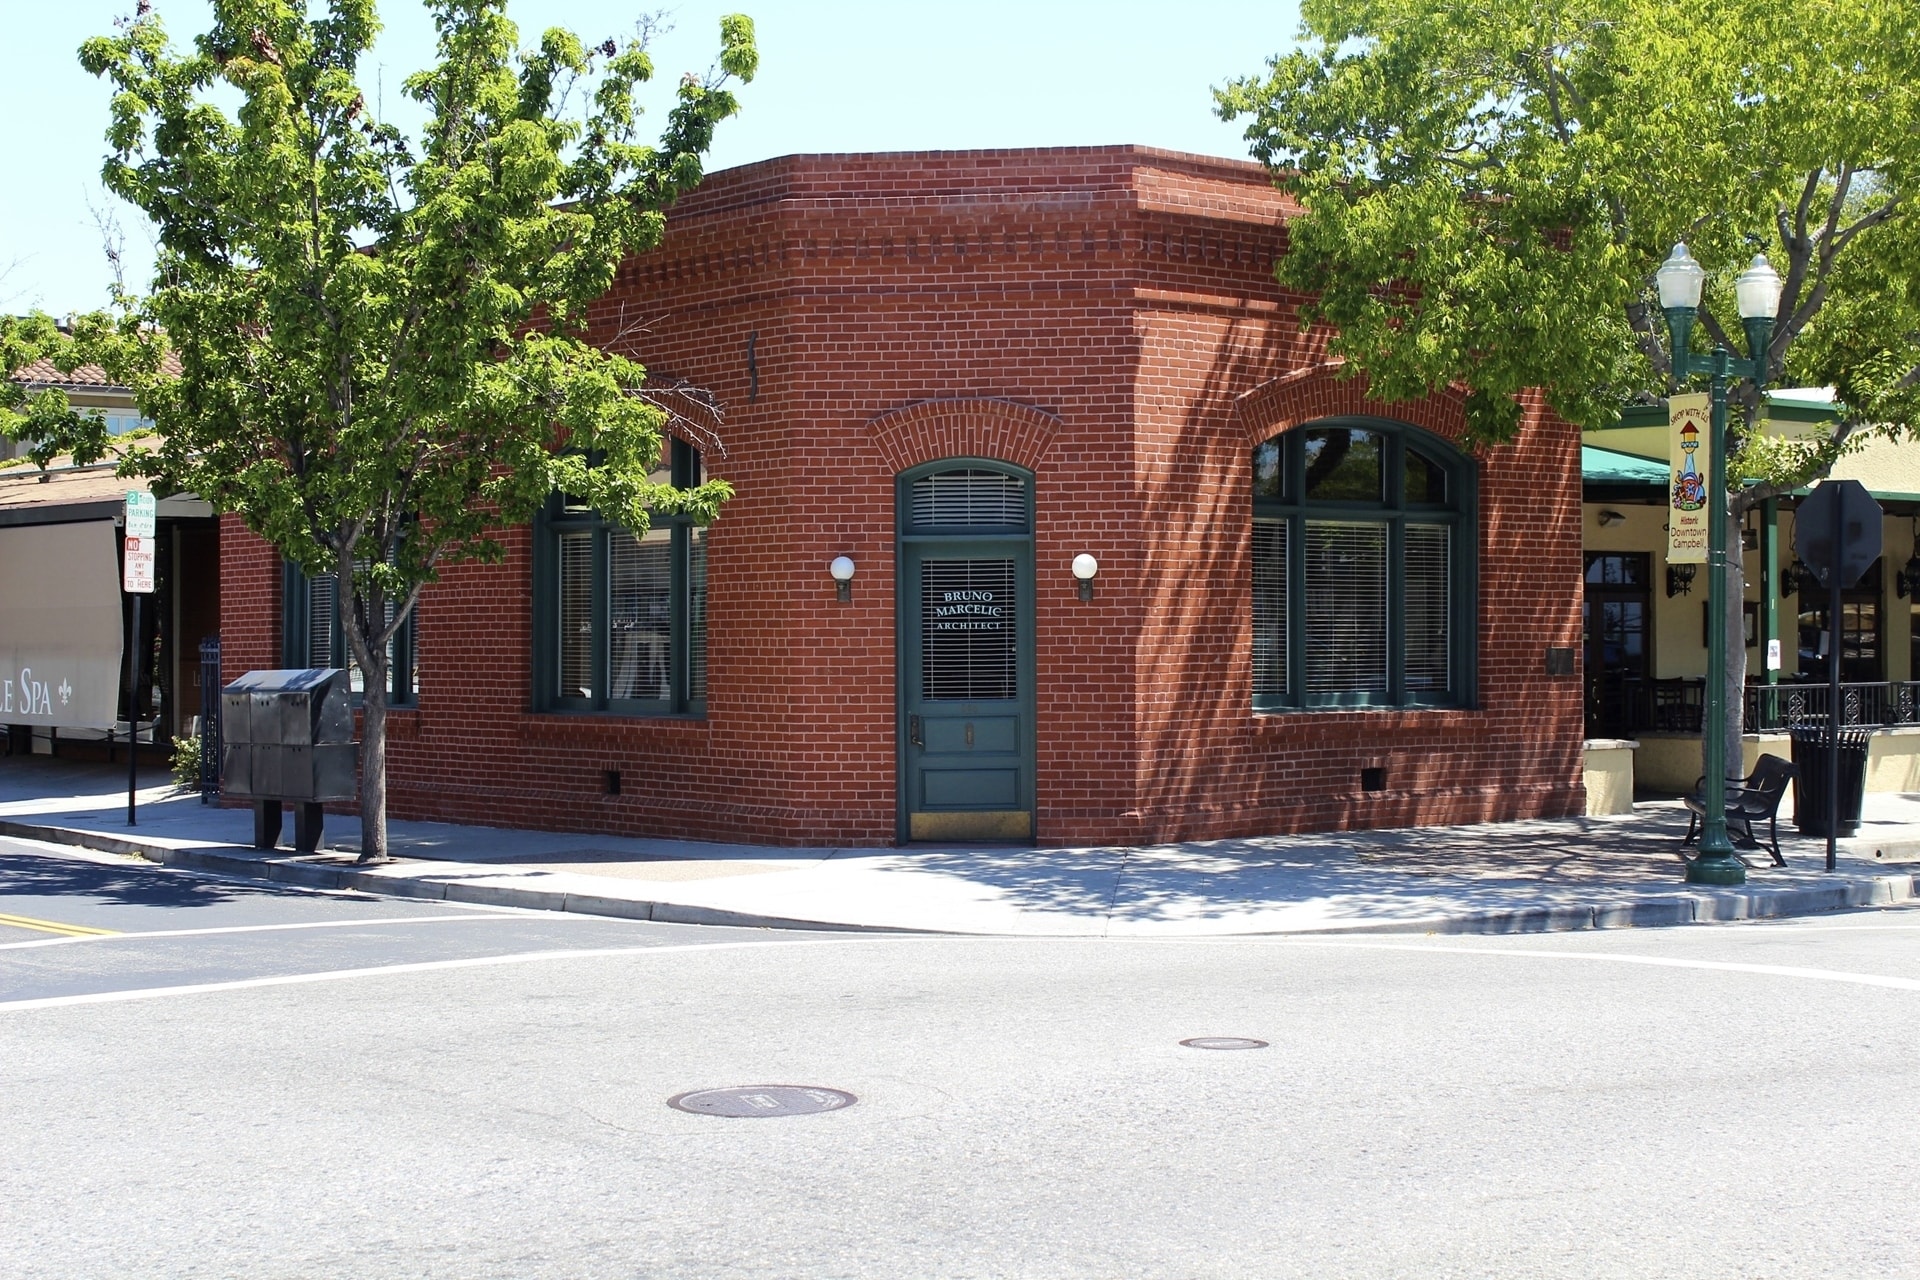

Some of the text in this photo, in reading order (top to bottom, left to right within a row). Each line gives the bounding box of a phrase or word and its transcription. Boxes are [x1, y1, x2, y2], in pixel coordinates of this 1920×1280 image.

[1670, 410, 1685, 426] SHOP
[1685, 408, 1700, 418] WITH
[129, 493, 136, 504] 2
[128, 508, 154, 519] PARKING
[1671, 527, 1707, 537] Downtown
[127, 539, 138, 550] NO
[128, 552, 152, 562] STOPPING
[127, 580, 152, 589] TO HERE
[943, 591, 993, 602] BRUNO
[936, 604, 1002, 617] MARCELIC
[936, 622, 1001, 630] ARCHITECT
[20, 667, 54, 715] SPA
